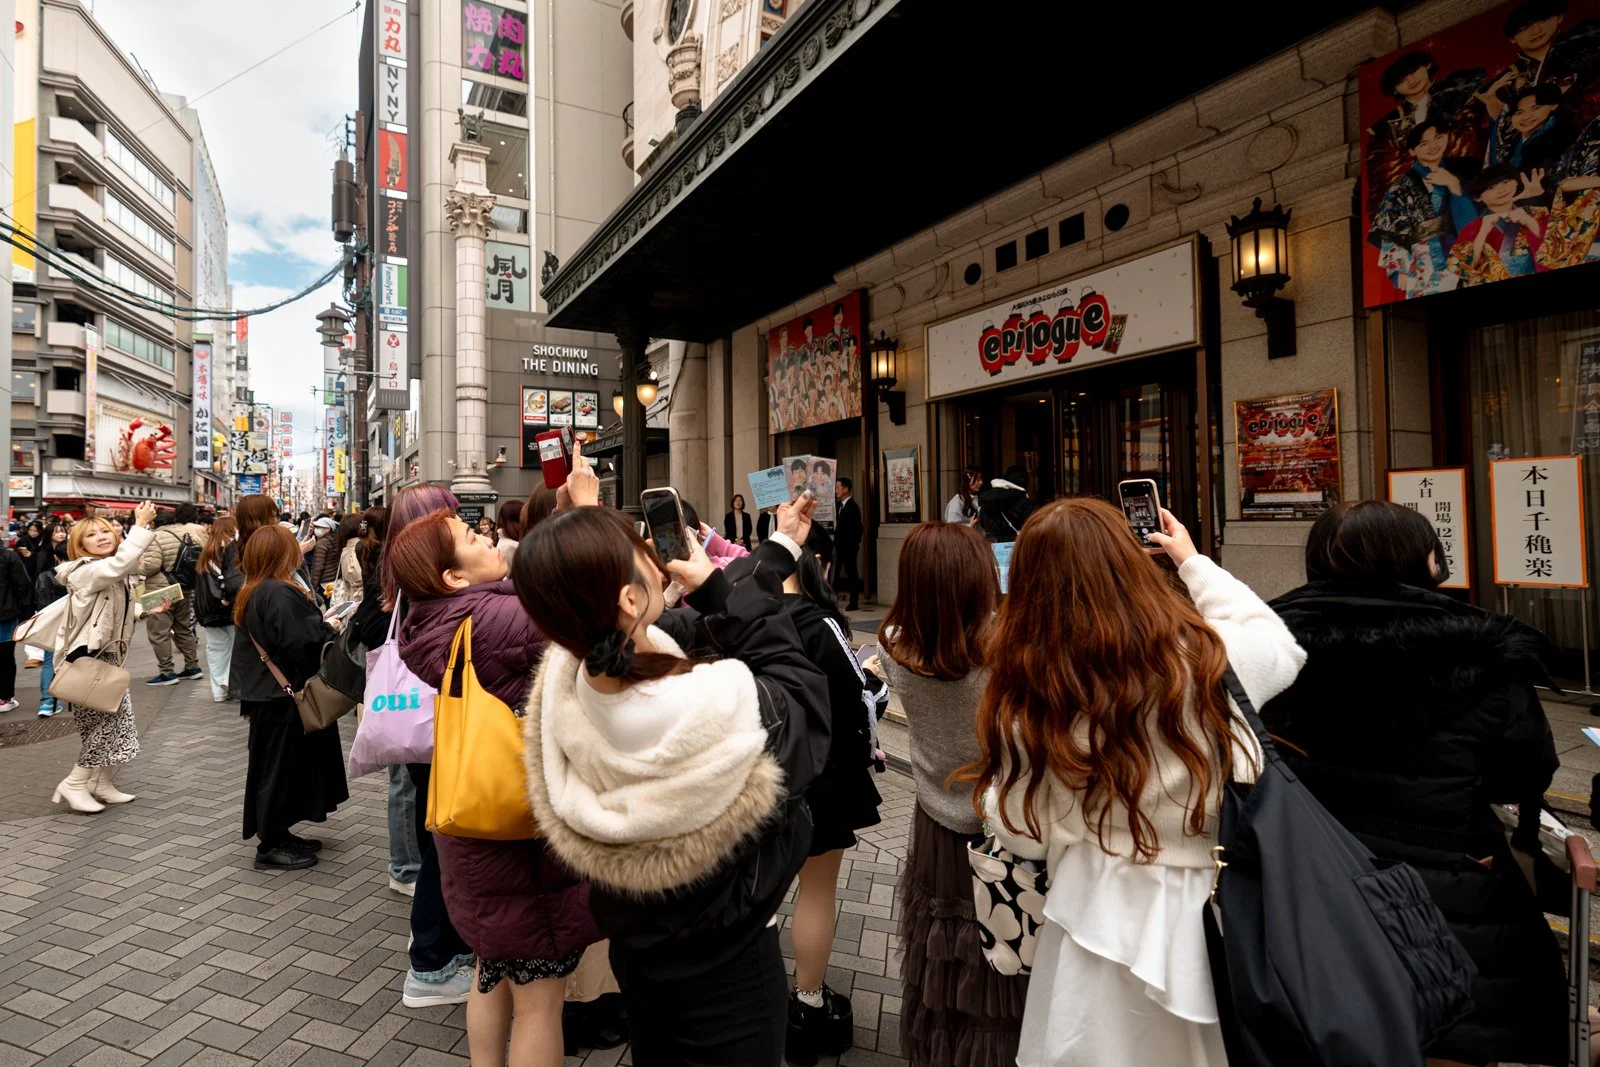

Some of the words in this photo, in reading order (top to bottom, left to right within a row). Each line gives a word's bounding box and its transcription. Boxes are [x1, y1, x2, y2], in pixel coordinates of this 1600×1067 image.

[385, 17, 401, 53] 力丸
[464, 2, 525, 45] 焼肉
[467, 42, 525, 80] 力丸
[387, 66, 399, 122] NYNY
[385, 265, 394, 306] FamilyMart
[486, 254, 528, 304] 風月
[983, 302, 1105, 363] epilogue
[522, 357, 547, 372] THE
[552, 359, 599, 376] DINING
[532, 344, 588, 360] SHOCHIKU
[1247, 412, 1319, 434] epilogue
[1418, 477, 1435, 499] 本日
[1521, 465, 1553, 578] 本日千穐楽
[371, 687, 421, 712] oui
